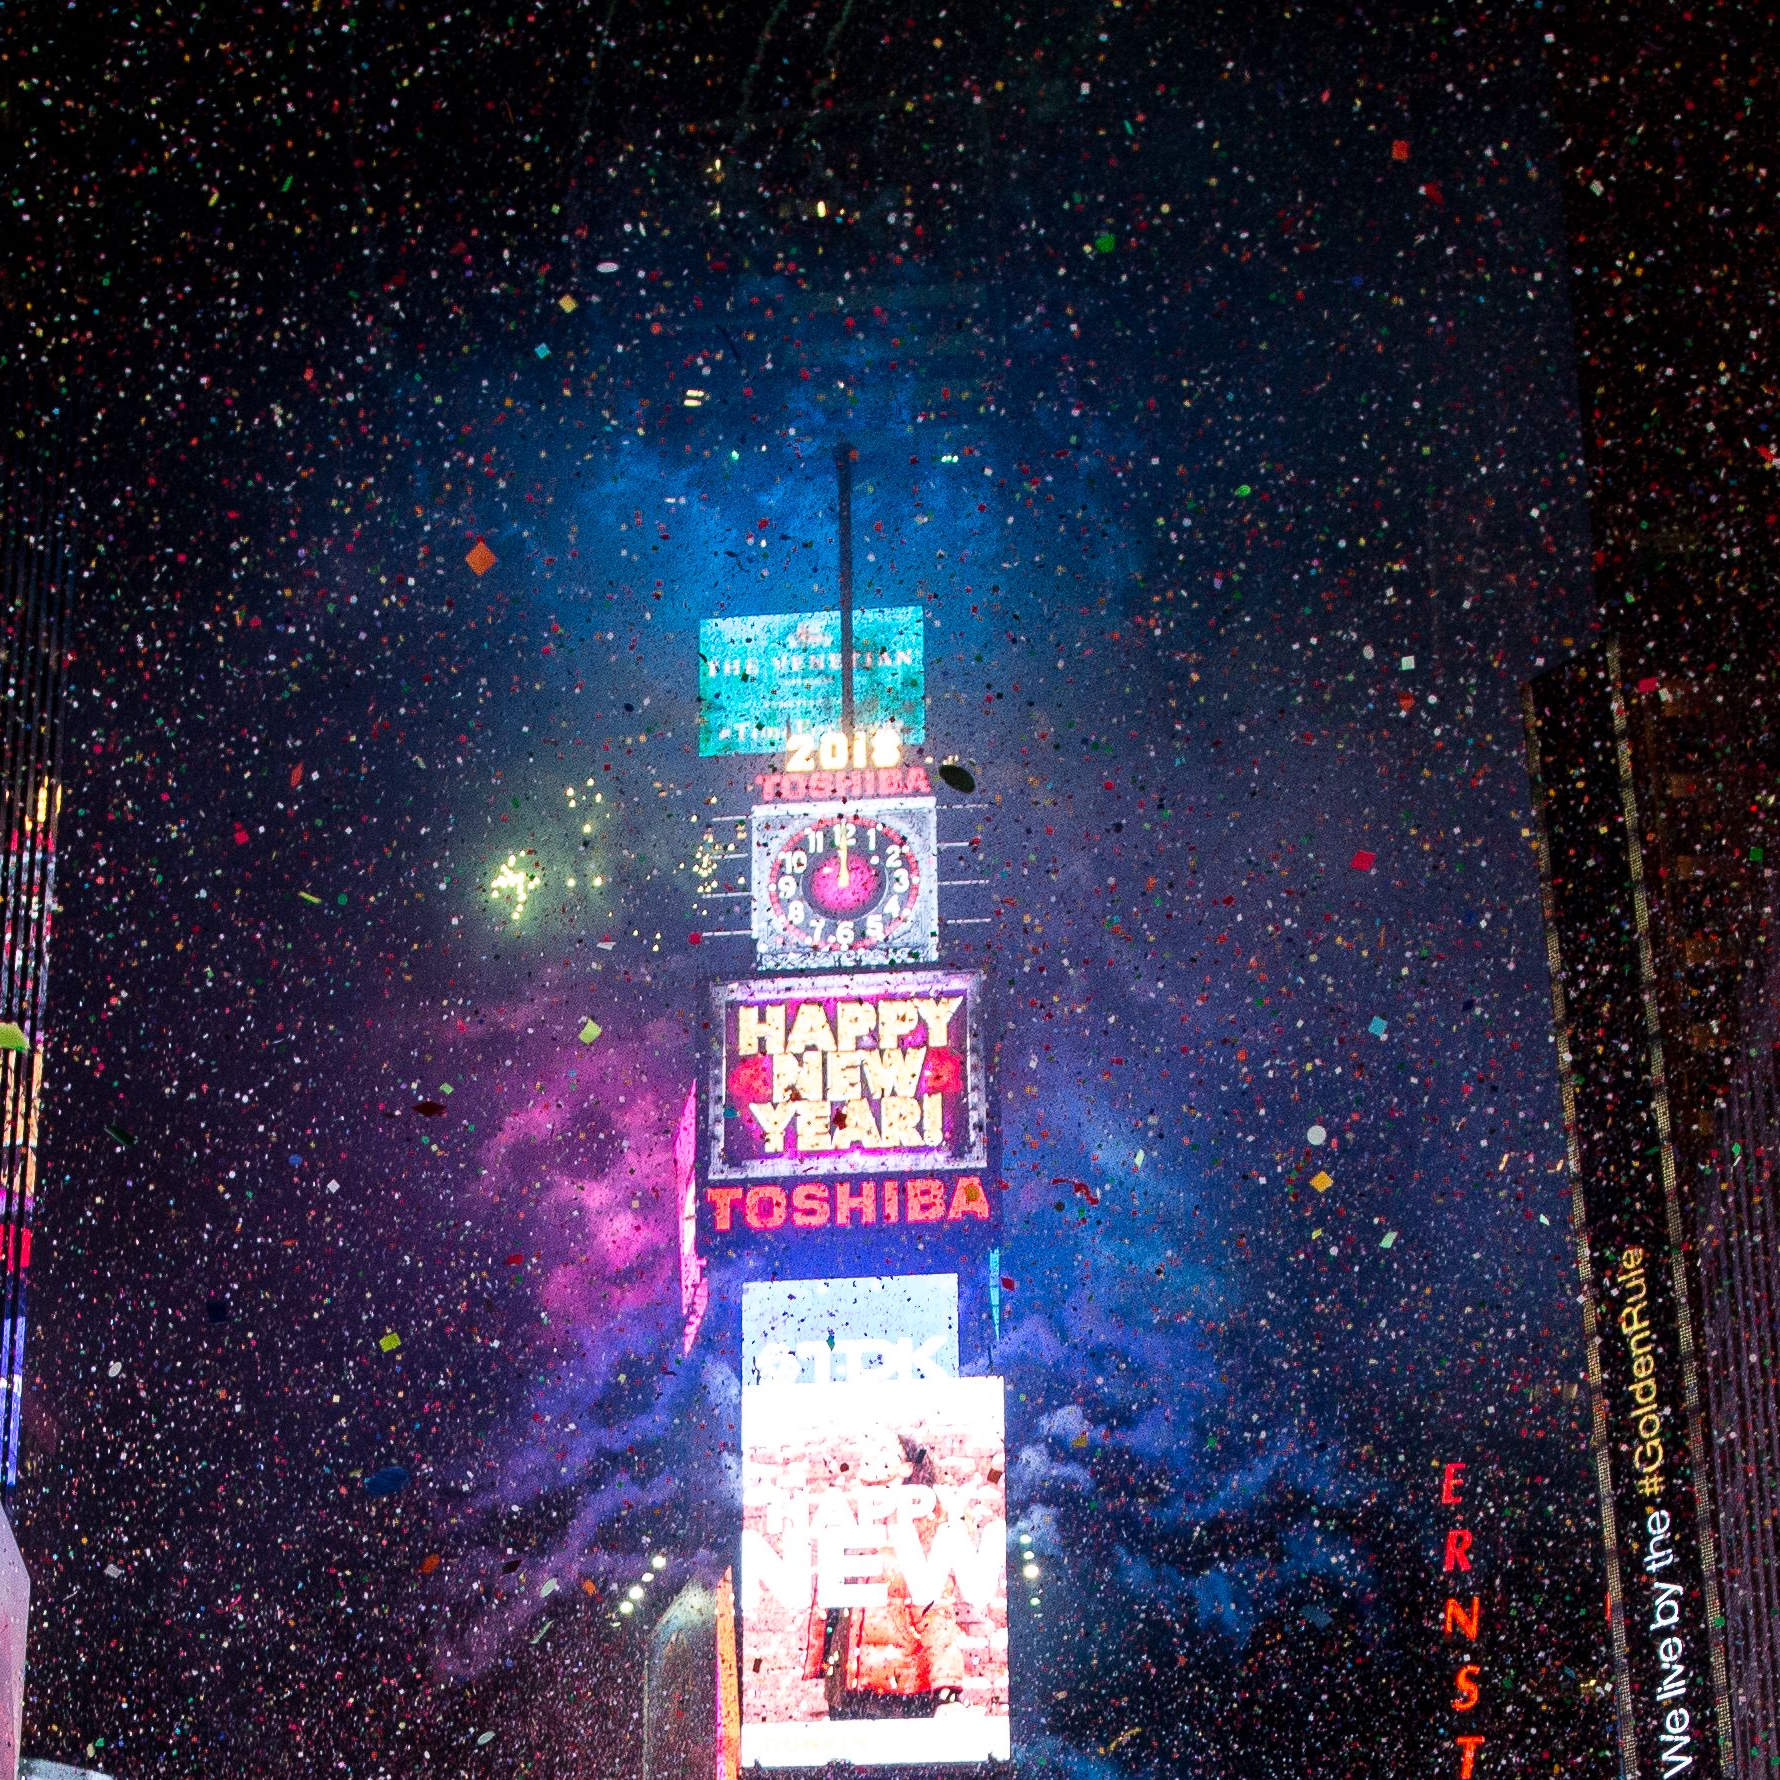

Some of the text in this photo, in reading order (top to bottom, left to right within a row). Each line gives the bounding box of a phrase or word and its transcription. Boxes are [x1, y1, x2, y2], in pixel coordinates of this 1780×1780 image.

[755, 767, 932, 803] TOSHIBA
[737, 997, 964, 1055] HAPPY
[772, 1047, 927, 1102] NEW
[751, 1095, 945, 1153] YEAR!
[707, 1175, 990, 1232] TOSHIBA
[1620, 1246, 1693, 1780] We live by the #GoldenRule
[743, 1515, 1006, 1608] NEW
[1441, 1462, 1480, 1780] ERNST
